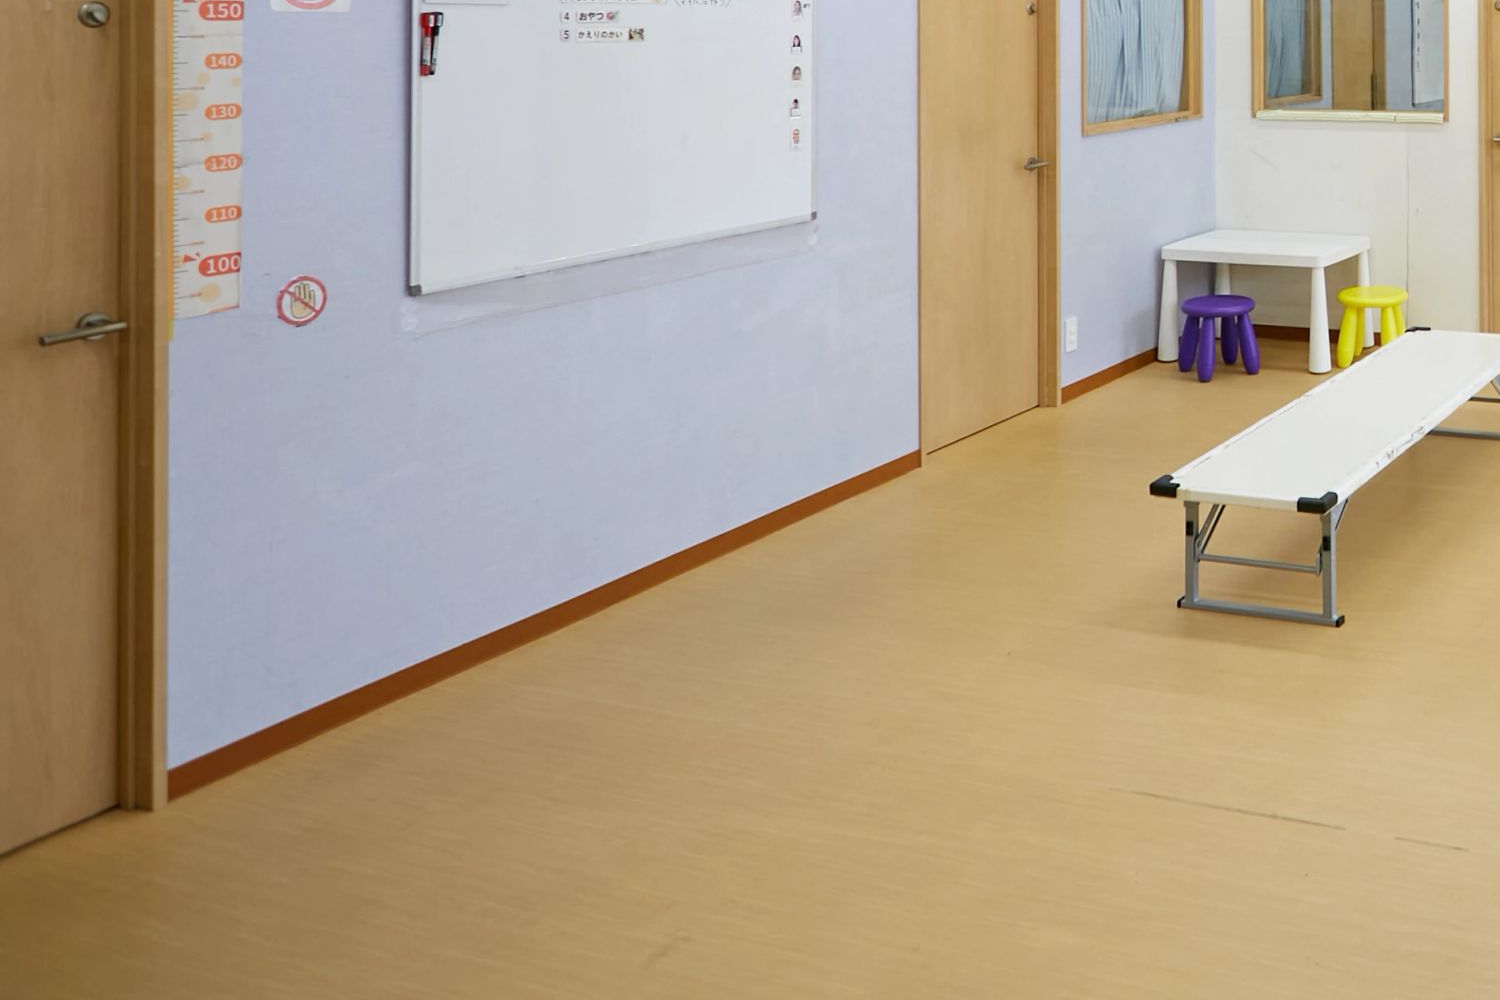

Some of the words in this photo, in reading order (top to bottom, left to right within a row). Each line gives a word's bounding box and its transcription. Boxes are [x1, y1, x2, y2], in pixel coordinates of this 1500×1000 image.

[205, 3, 242, 19] 150
[578, 11, 605, 21] おやつ
[577, 30, 623, 39] かえりのかい
[209, 55, 237, 67] 140
[210, 105, 237, 119] 130
[210, 156, 238, 170] 120
[210, 207, 237, 221] 110
[207, 255, 241, 274] 100
